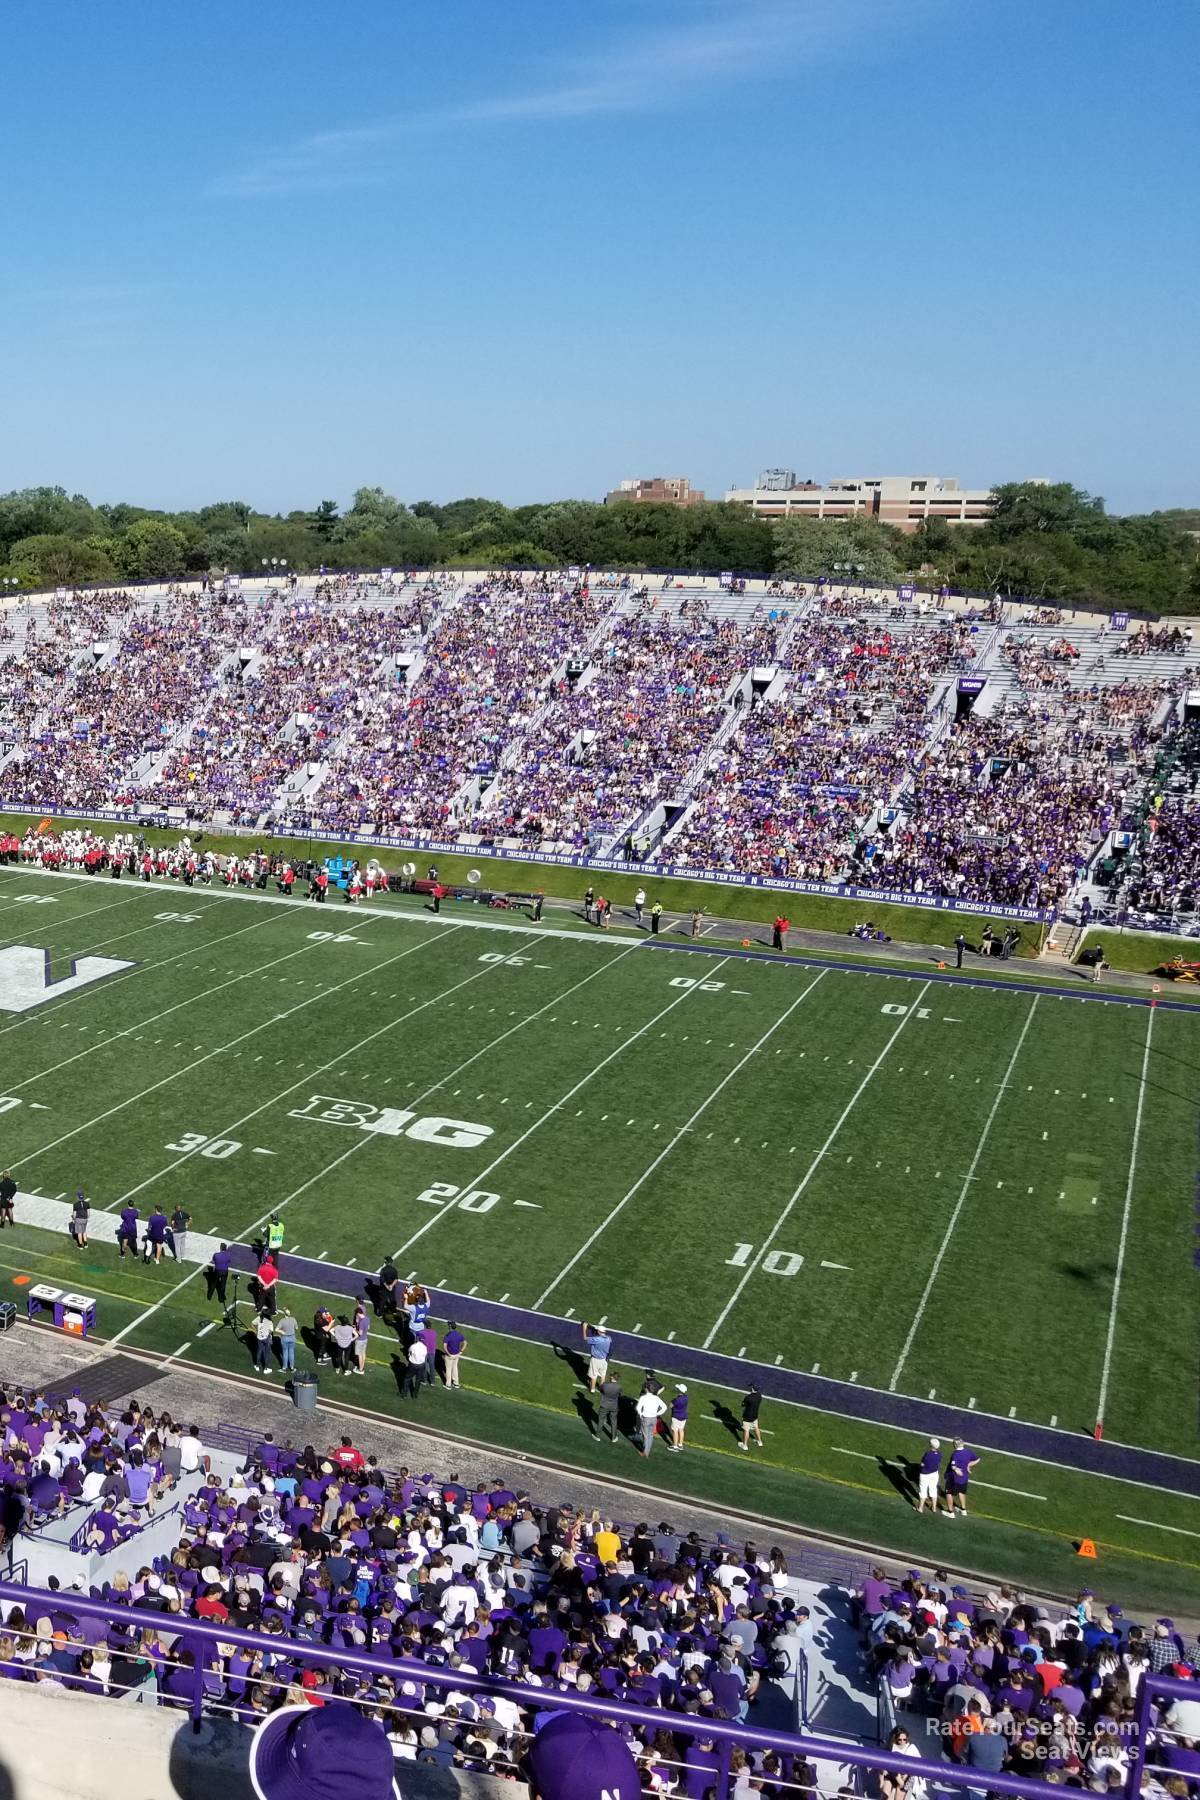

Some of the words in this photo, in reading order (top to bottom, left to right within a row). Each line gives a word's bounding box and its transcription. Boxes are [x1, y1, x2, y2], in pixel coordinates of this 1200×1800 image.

[901, 589, 912, 598] 110
[1116, 617, 1126, 626] 111
[588, 860, 616, 869] CHICAGO'S
[618, 862, 627, 870] BIG
[629, 863, 640, 871] TEN
[641, 864, 657, 873] TEAM
[663, 866, 668, 874] N
[674, 869, 703, 879] CHICAGO'S
[705, 871, 714, 880] BIG
[716, 872, 728, 881] TEN
[729, 873, 746, 883] TEAM
[752, 876, 757, 885] N
[763, 879, 794, 890] CHICAGO'S
[795, 882, 805, 891] BIG
[807, 883, 820, 892] TEN
[821, 884, 838, 894] TEAM
[844, 888, 850, 896] N
[857, 889, 889, 901] CHICAGO'S
[891, 892, 902, 902] BIG
[903, 894, 916, 904] TEN
[918, 895, 936, 906] TEAM
[942, 899, 949, 907] N
[955, 901, 989, 913] CHICAGO'S
[991, 905, 1002, 915] BIG
[1004, 906, 1018, 916] TEN
[1020, 908, 1039, 918] TEAM
[153, 911, 203, 923] 50
[306, 931, 358, 942] 40
[477, 953, 532, 966] 30
[668, 977, 726, 992] 20
[880, 1003, 932, 1019] 10
[164, 1132, 243, 1159] 30
[416, 1182, 501, 1213] 20
[725, 1242, 805, 1276] 10
[500, 1646, 515, 1664] 11
